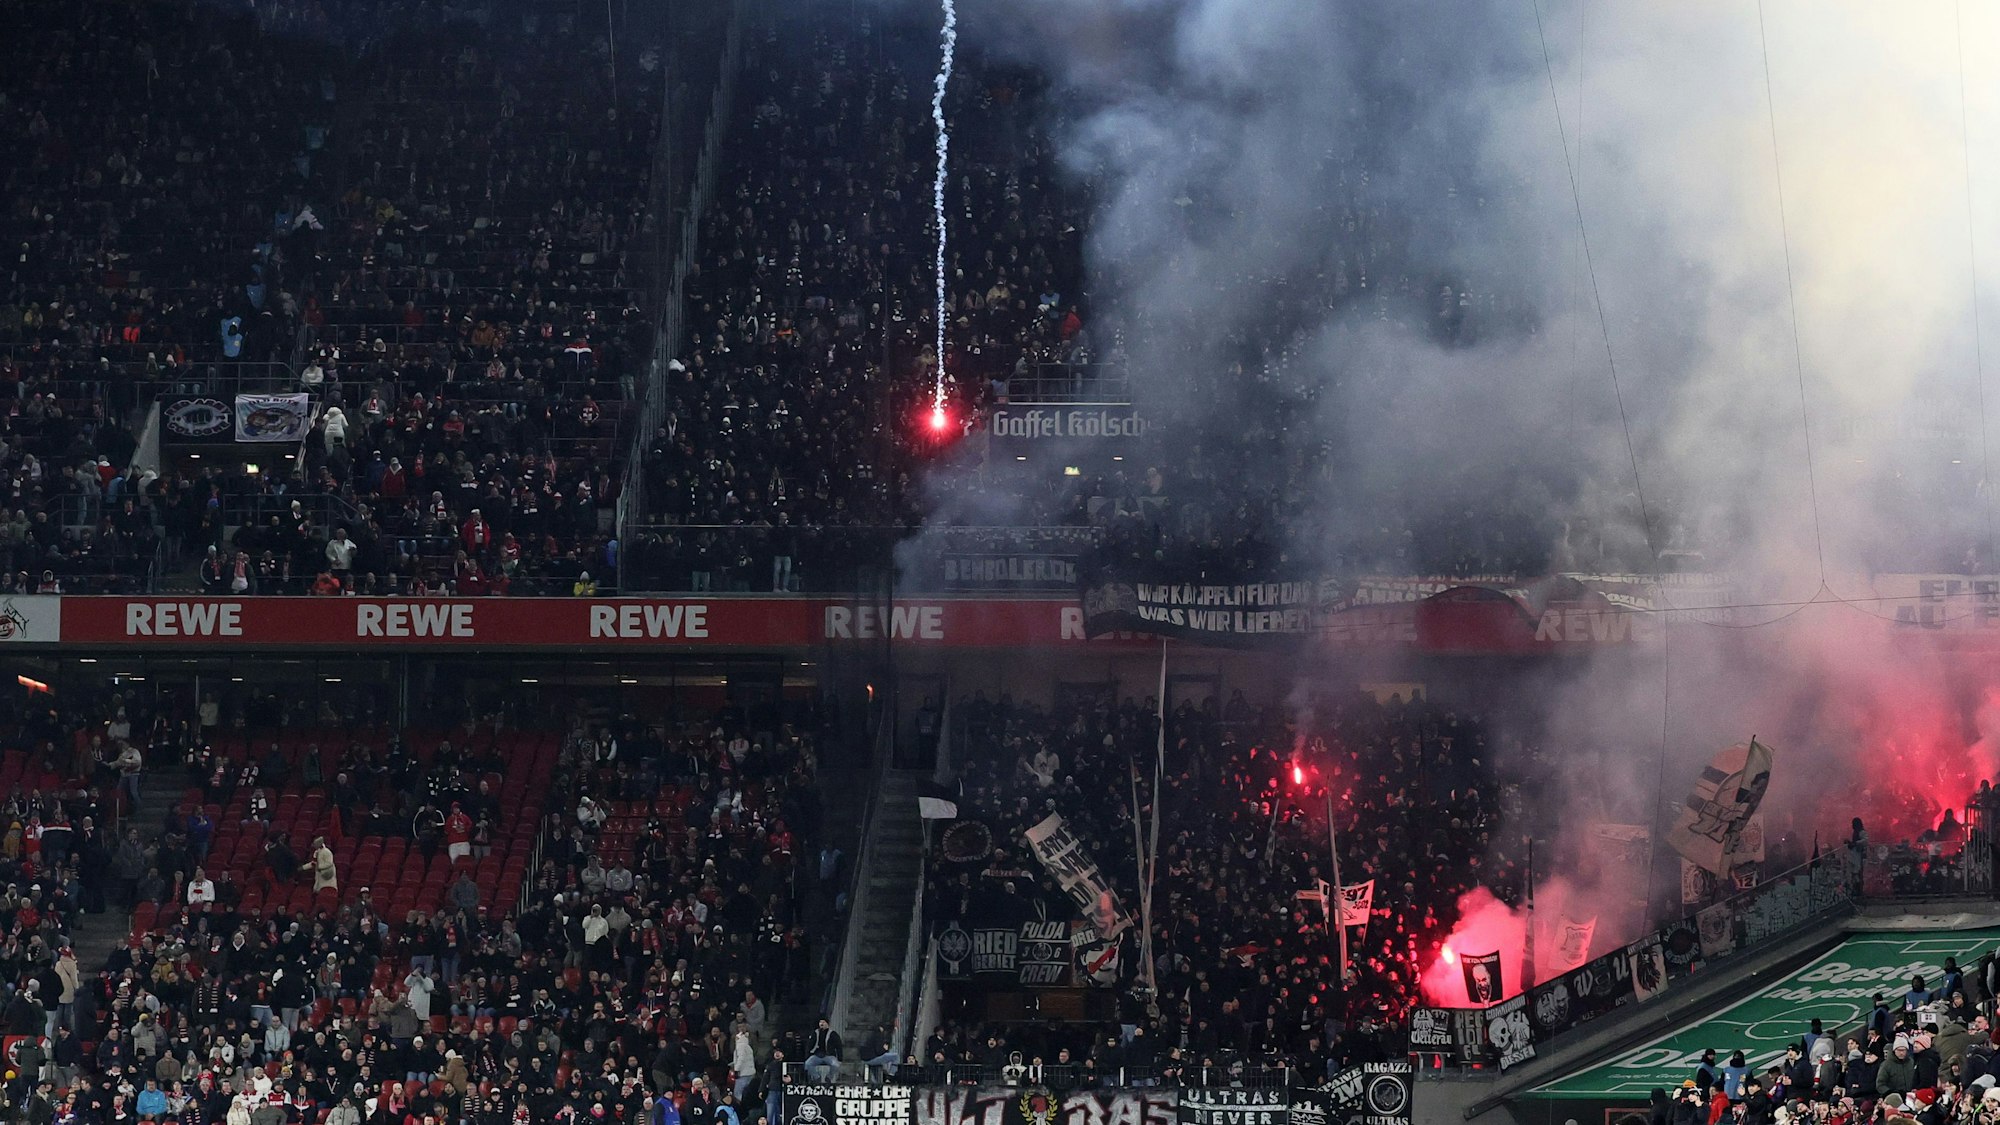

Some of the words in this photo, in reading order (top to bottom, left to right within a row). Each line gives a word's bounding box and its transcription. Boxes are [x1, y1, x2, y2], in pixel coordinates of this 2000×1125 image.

[993, 410, 1063, 438] Gaffel
[1068, 410, 1148, 438] Kölsch
[1137, 583, 1169, 604] WIR
[1247, 582, 1280, 606] FÜR
[126, 603, 243, 636] REWE
[357, 604, 475, 637] REWE
[589, 604, 709, 638] REWE
[825, 605, 945, 640] REWE
[1137, 605, 1184, 626] WAS
[1188, 609, 1230, 632] WIR
[1233, 610, 1312, 634] LIEBEN
[1020, 921, 1066, 940] FULDA
[973, 931, 1018, 954] RIED
[1021, 946, 1029, 958] 3
[1053, 947, 1062, 958] 6
[974, 955, 1017, 970] GEBIET
[1020, 964, 1063, 984] CREW
[1409, 1030, 1453, 1046] Wetterau
[1363, 1062, 1412, 1074] RAGAZZI
[835, 1085, 871, 1100] EHRE
[1187, 1088, 1280, 1105] ULTRAS
[835, 1099, 911, 1118] GRUPPE
[1195, 1109, 1272, 1125] NEVER
[1366, 1116, 1409, 1125] ULTRAS
